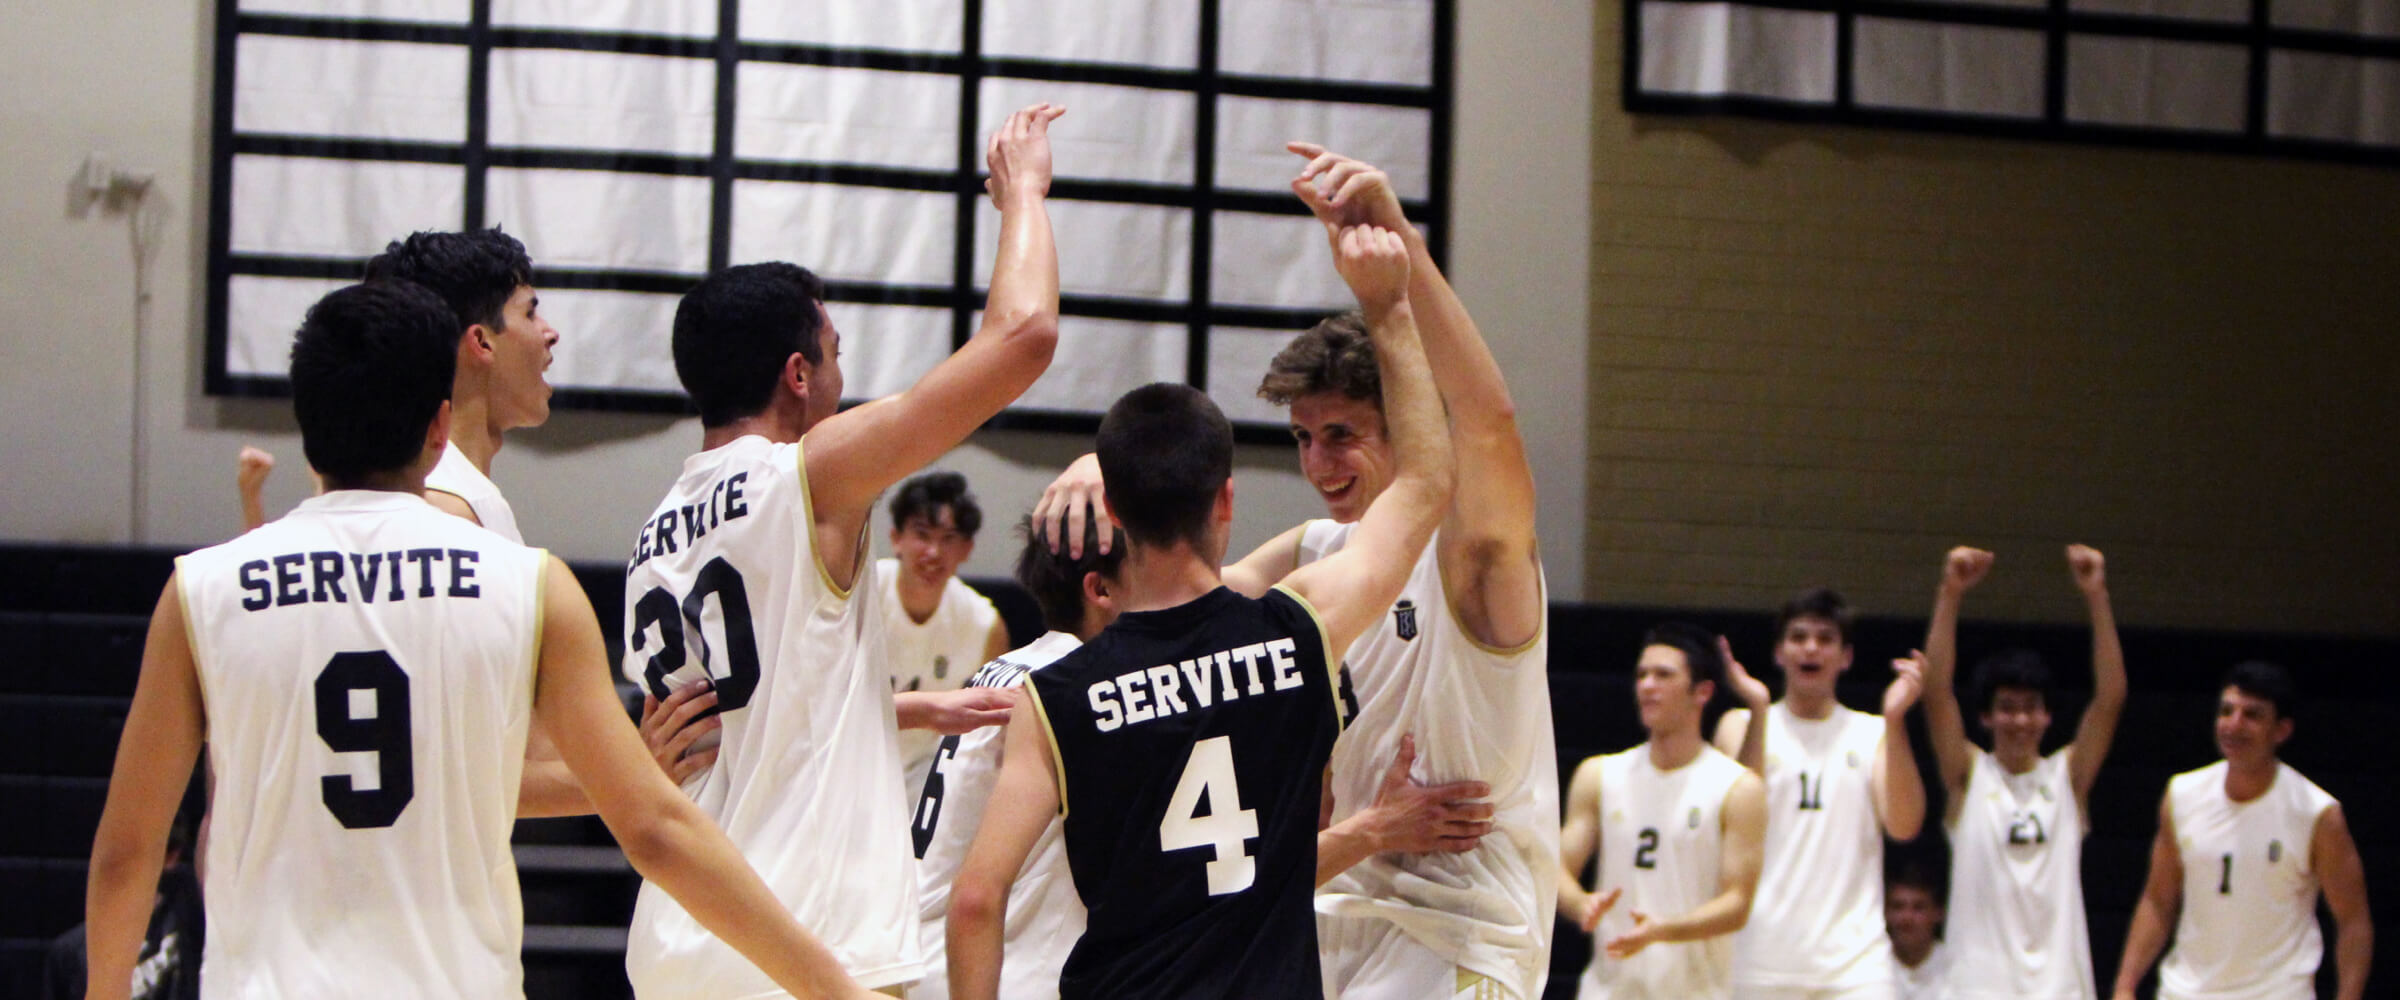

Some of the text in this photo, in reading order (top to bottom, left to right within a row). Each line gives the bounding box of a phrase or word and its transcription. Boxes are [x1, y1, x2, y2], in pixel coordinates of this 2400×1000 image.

[239, 548, 481, 612] SERVITE
[632, 556, 761, 716] 20
[1087, 637, 1304, 732] SERVITE
[314, 650, 415, 829] 9
[911, 735, 961, 860] 6
[1160, 736, 1259, 896] 4
[1798, 770, 1823, 811] 11
[1634, 828, 1660, 869] 2
[2219, 853, 2233, 896] 1
